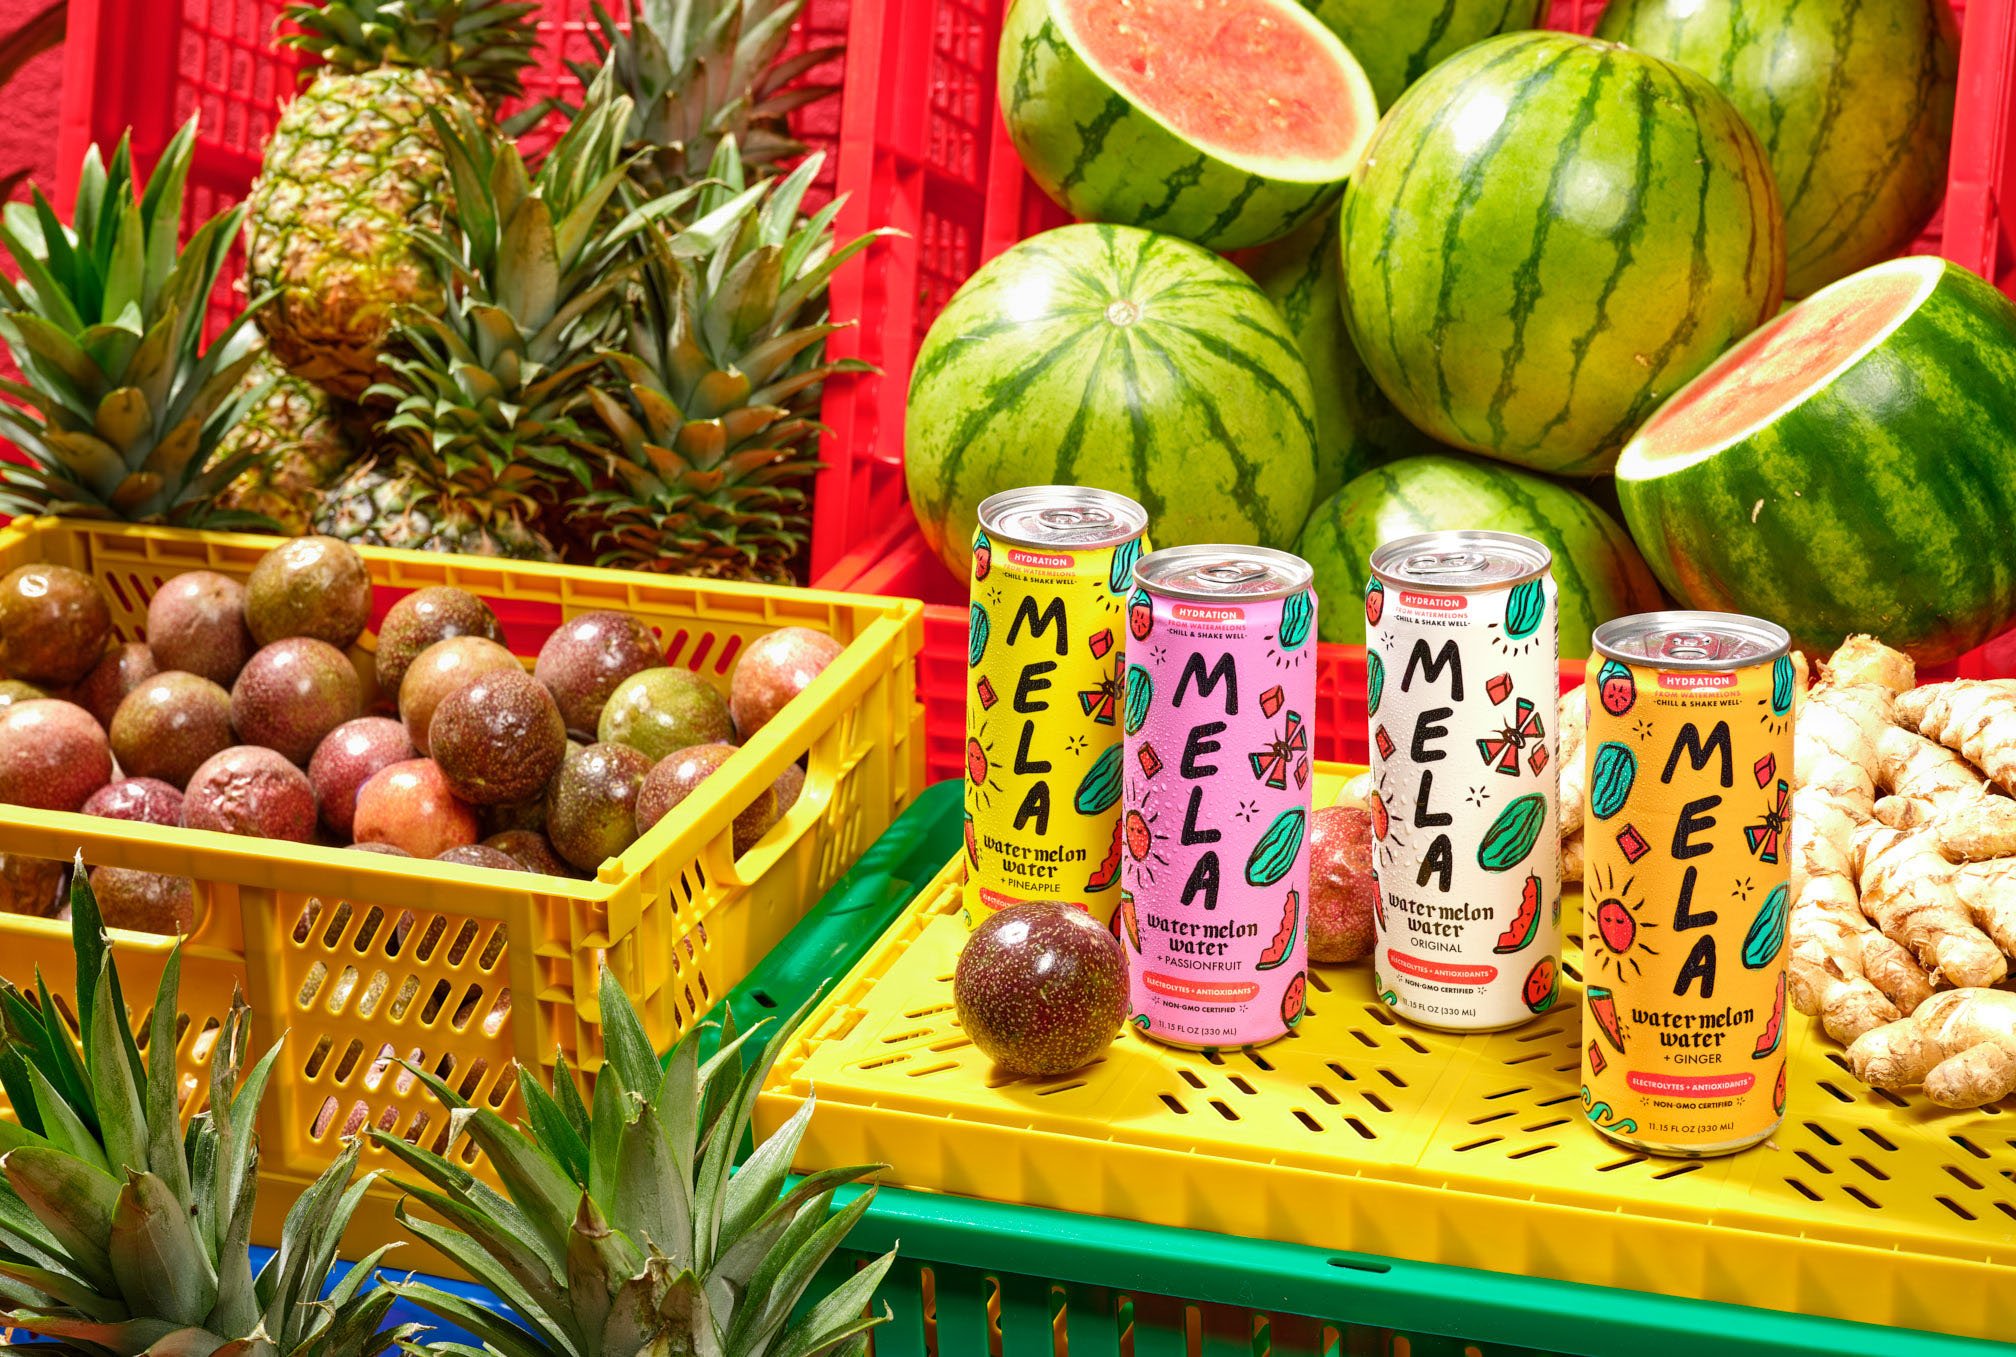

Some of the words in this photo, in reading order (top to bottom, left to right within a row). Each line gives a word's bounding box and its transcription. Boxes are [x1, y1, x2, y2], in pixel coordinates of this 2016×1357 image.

[1014, 553, 1067, 566] HYDRATION
[1004, 564, 1022, 572] FROM
[1023, 568, 1076, 577] WATERMELONS
[1405, 595, 1459, 607] HYDRATION
[1180, 608, 1237, 619] HYDRATION
[1414, 610, 1468, 619] WATERMELONS
[1168, 620, 1188, 628] FROM
[1190, 623, 1246, 631] WATERMELONS
[1666, 677, 1729, 686] HYDRATION
[1654, 690, 1678, 698] FROM
[1680, 690, 1741, 698] WATERMELONS
[1006, 595, 1068, 836] MELA
[1401, 639, 1464, 893] MELA
[1172, 651, 1239, 911] MELA
[983, 834, 1087, 862] watermelon
[1660, 720, 1733, 999] MELA
[1002, 858, 1058, 878] water
[1008, 878, 1061, 893] PINEAPPLE
[1389, 892, 1494, 921] watermelon
[1147, 913, 1258, 939] watermelon
[1408, 917, 1464, 938] water
[1169, 938, 1229, 956] water
[1410, 937, 1462, 953] ORIGINAL
[1165, 955, 1242, 971] PASSIONFRUIT
[1391, 955, 1428, 974] ELECTROLYTES
[1146, 977, 1190, 994] ELECTROLYTES
[1405, 978, 1439, 992] NON-GMO
[1163, 1000, 1200, 1012] NON-GMO
[1402, 997, 1417, 1009] 11.15
[1418, 1003, 1426, 1011] FL
[1427, 1005, 1439, 1014] OZ
[1441, 1007, 1459, 1016] (330
[1461, 1008, 1476, 1017] ML)
[1631, 1006, 1754, 1029] watermelon
[1159, 1020, 1176, 1031] 11.15
[1177, 1025, 1185, 1033] FL
[1187, 1026, 1199, 1035] OZ
[1201, 1027, 1220, 1036] (330
[1222, 1027, 1237, 1036] ML)
[1660, 1031, 1726, 1048] water
[1674, 1053, 1722, 1064] GINGER
[1632, 1077, 1684, 1091] ELECTROLYTES
[1653, 1101, 1696, 1110] NON-GMO
[1698, 1101, 1733, 1109] CERTIFIED
[1649, 1122, 1668, 1132] 11.15
[1682, 1125, 1695, 1133] OZ
[1698, 1124, 1717, 1134] (330
[1720, 1122, 1734, 1131] ML)
